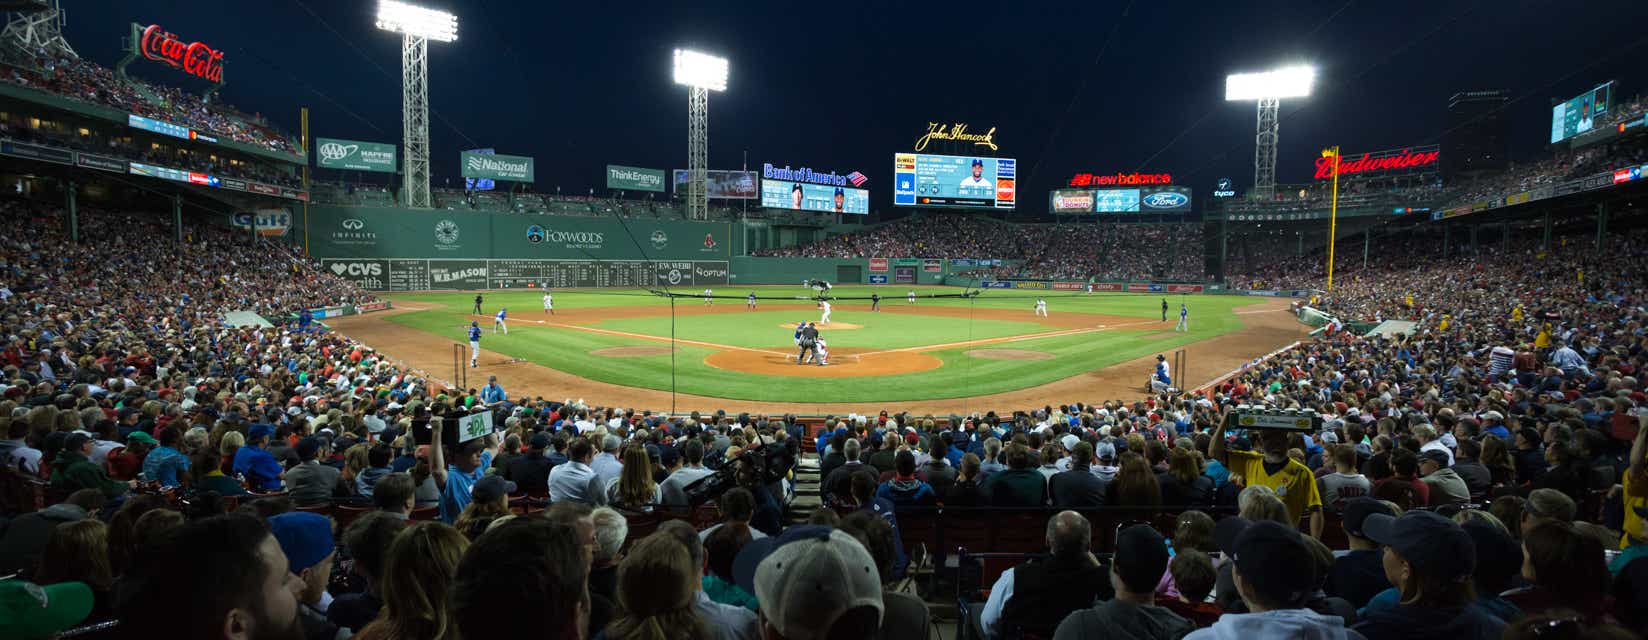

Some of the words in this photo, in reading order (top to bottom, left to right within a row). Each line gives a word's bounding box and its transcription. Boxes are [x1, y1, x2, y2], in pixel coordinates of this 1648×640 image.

[915, 121, 950, 152] John
[951, 123, 998, 150] Hancock
[482, 158, 527, 173] National
[1314, 150, 1440, 179] Budweiser
[610, 169, 659, 185] ThinkEnergy
[763, 163, 793, 181] Bank
[794, 167, 805, 182] of
[805, 168, 846, 186] America
[1093, 176, 1115, 185] new
[1117, 172, 1171, 184] balance
[1151, 196, 1178, 206] Ford
[232, 211, 287, 226] Gulf
[347, 262, 383, 276] CVS
[703, 270, 726, 278] OPTUM
